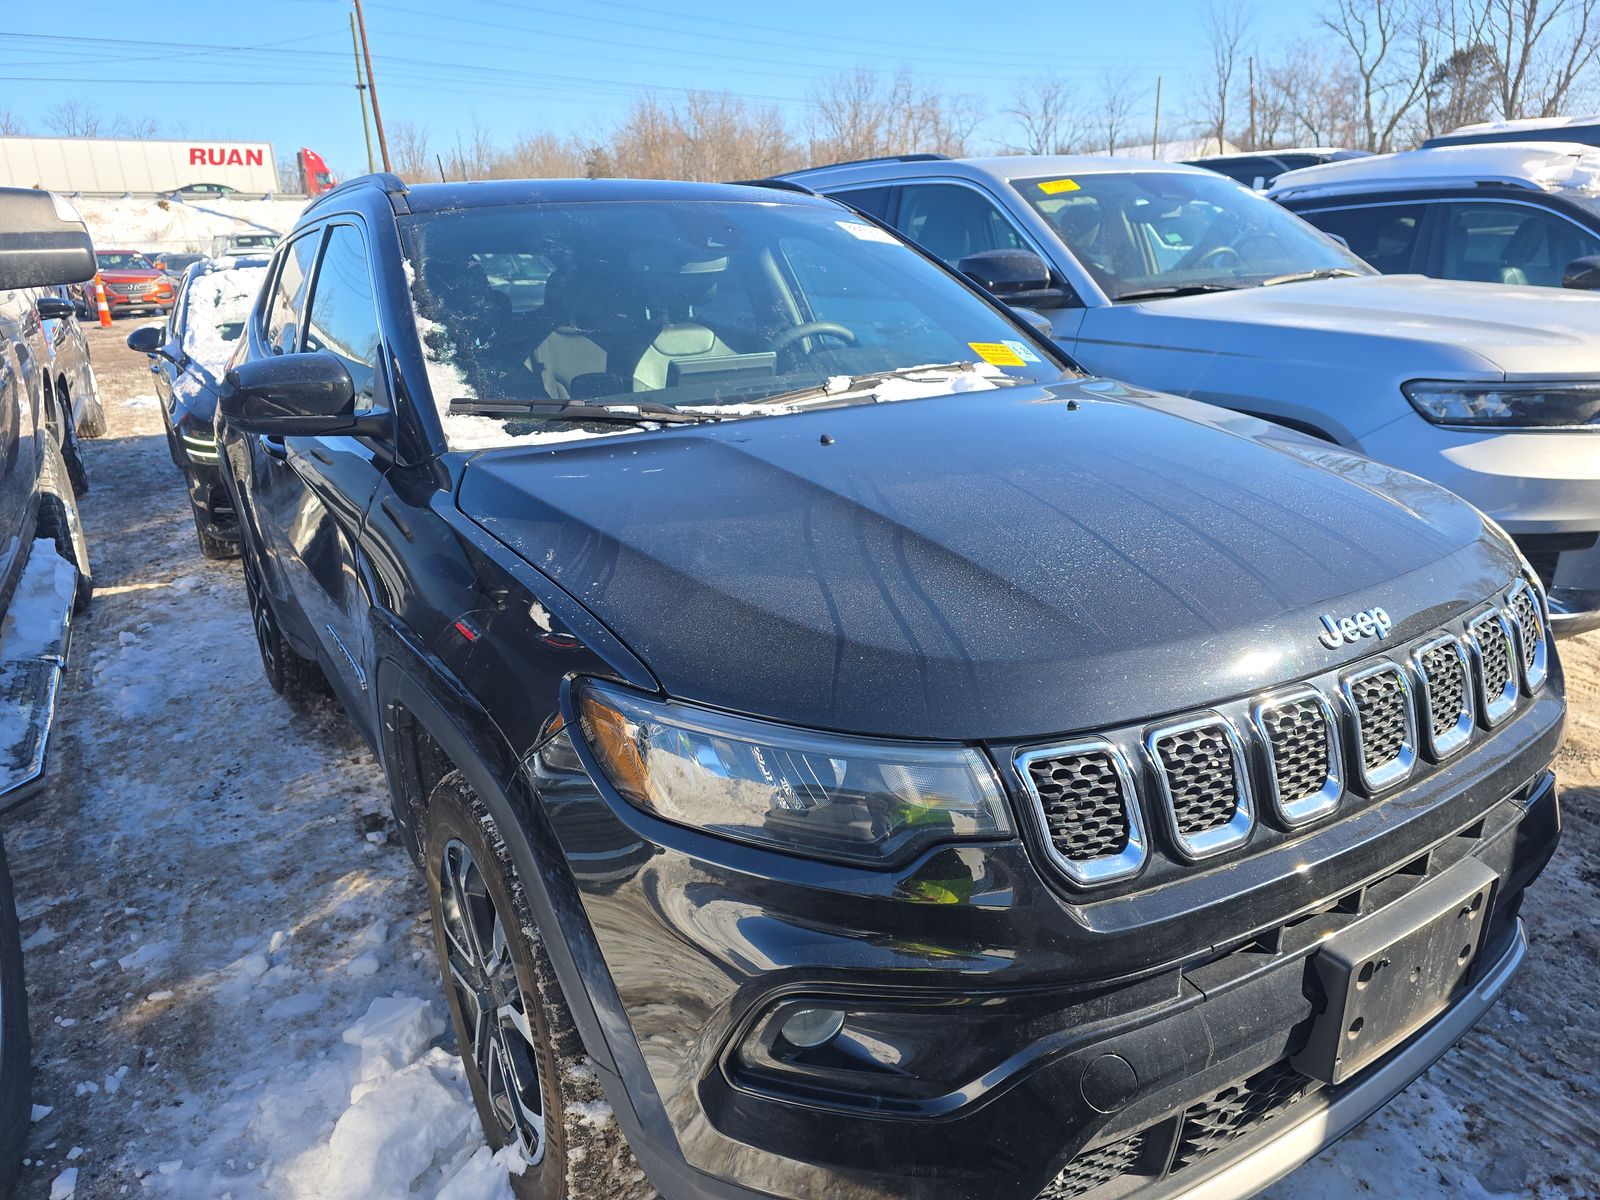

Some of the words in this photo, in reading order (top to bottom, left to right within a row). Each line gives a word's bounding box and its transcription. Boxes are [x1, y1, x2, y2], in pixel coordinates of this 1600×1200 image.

[189, 148, 263, 166] RUAN
[1318, 606, 1392, 650] Jeep
[522, 990, 558, 1147] Continental
